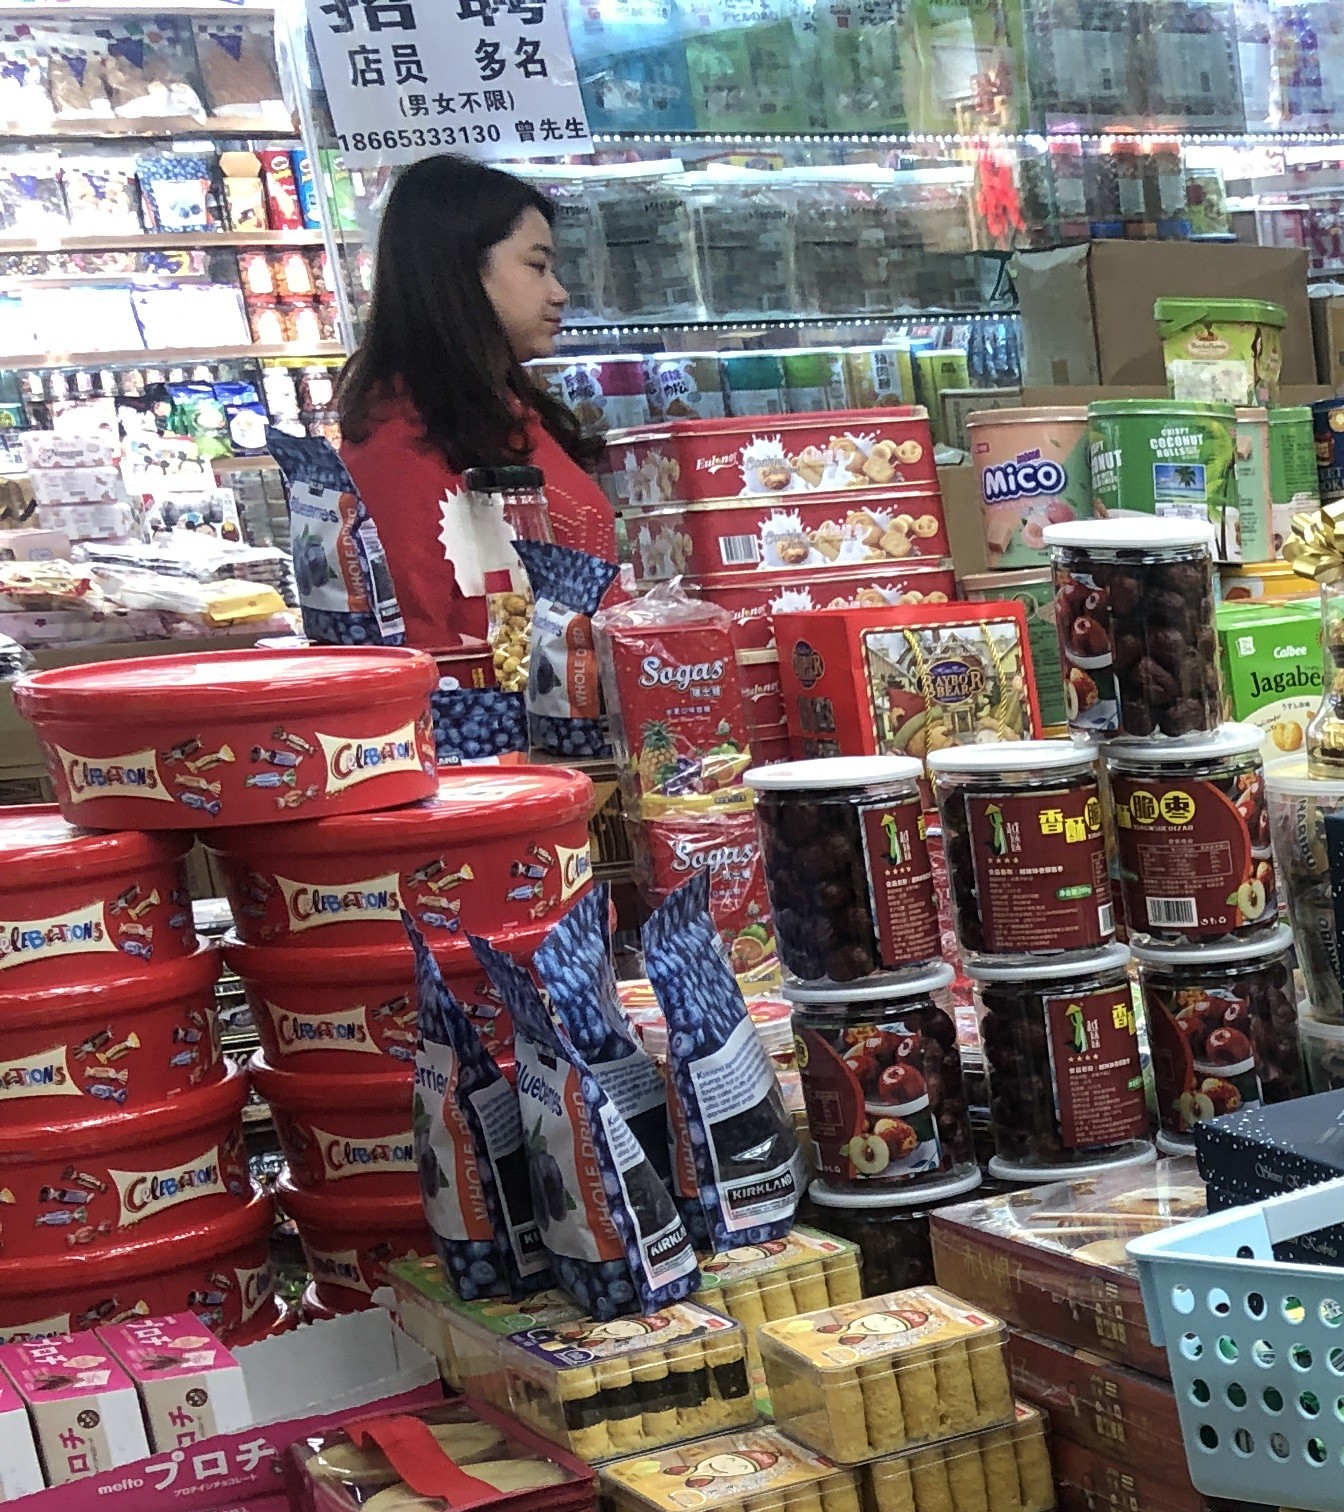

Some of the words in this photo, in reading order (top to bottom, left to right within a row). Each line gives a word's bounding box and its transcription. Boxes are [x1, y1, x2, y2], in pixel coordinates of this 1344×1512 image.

[347, 45, 428, 87] 店员
[475, 36, 548, 81] 多名
[399, 90, 515, 118] (男女不限)
[337, 124, 501, 152] 18665333130
[514, 117, 588, 142] 曾先生
[1149, 433, 1204, 450] COCONUT
[1273, 645, 1308, 660] Calbee
[640, 657, 726, 690] Sogas
[731, 1173, 794, 1201] KIRKLAND
[97, 1476, 145, 1496] meito
[145, 1437, 277, 1491] プロチ
